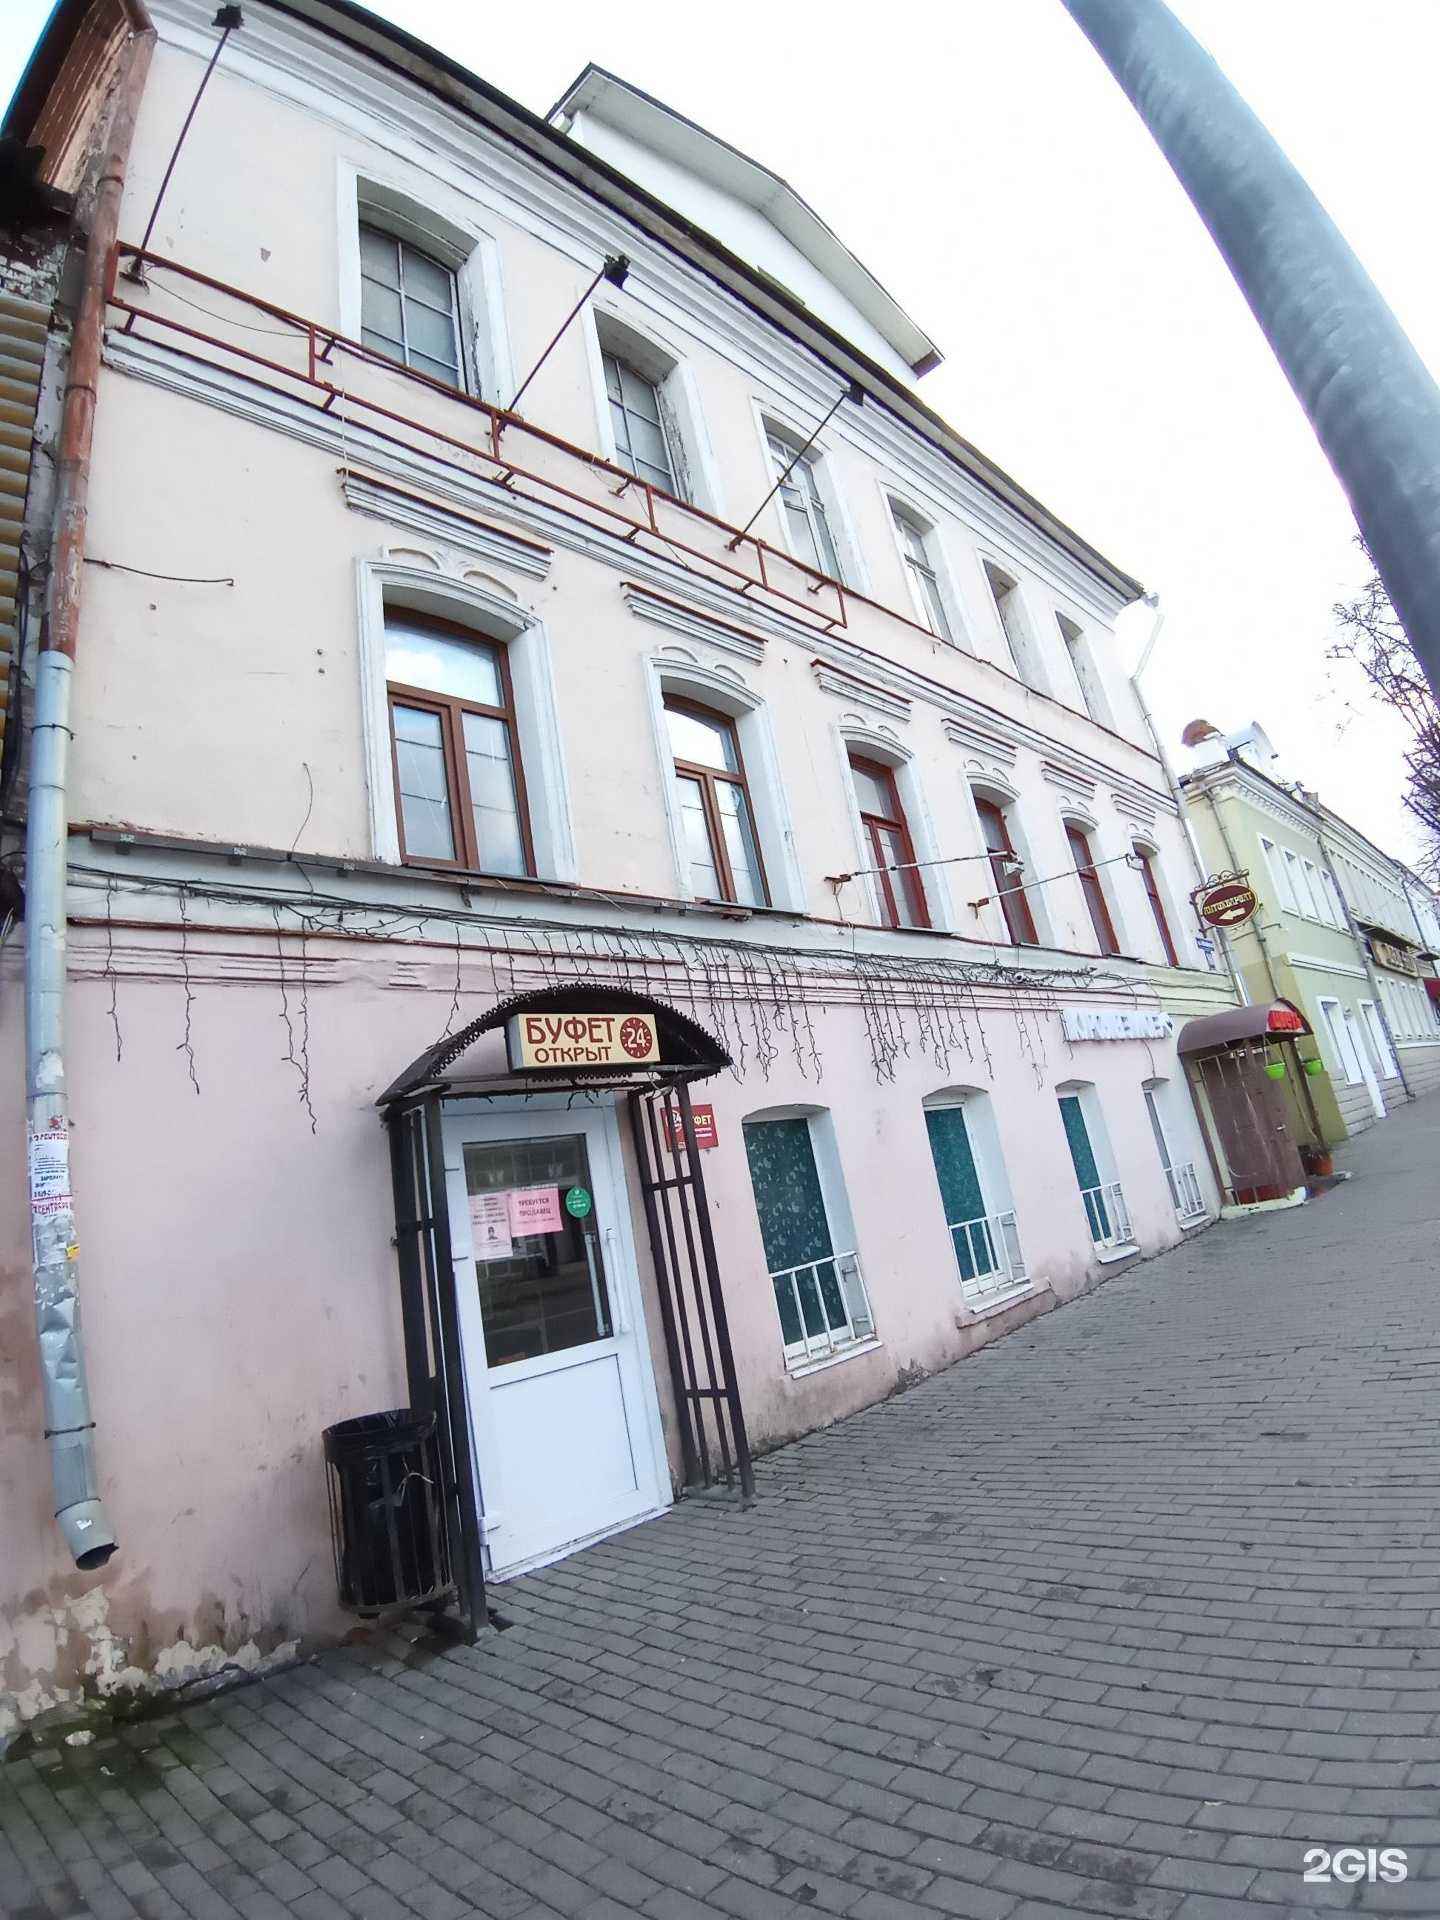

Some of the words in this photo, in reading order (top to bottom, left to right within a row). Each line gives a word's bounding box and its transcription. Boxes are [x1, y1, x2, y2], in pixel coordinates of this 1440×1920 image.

[525, 1016, 615, 1044] БУФЕТ
[626, 1027, 646, 1048] 24
[534, 1046, 611, 1063] ОТКРЫТ
